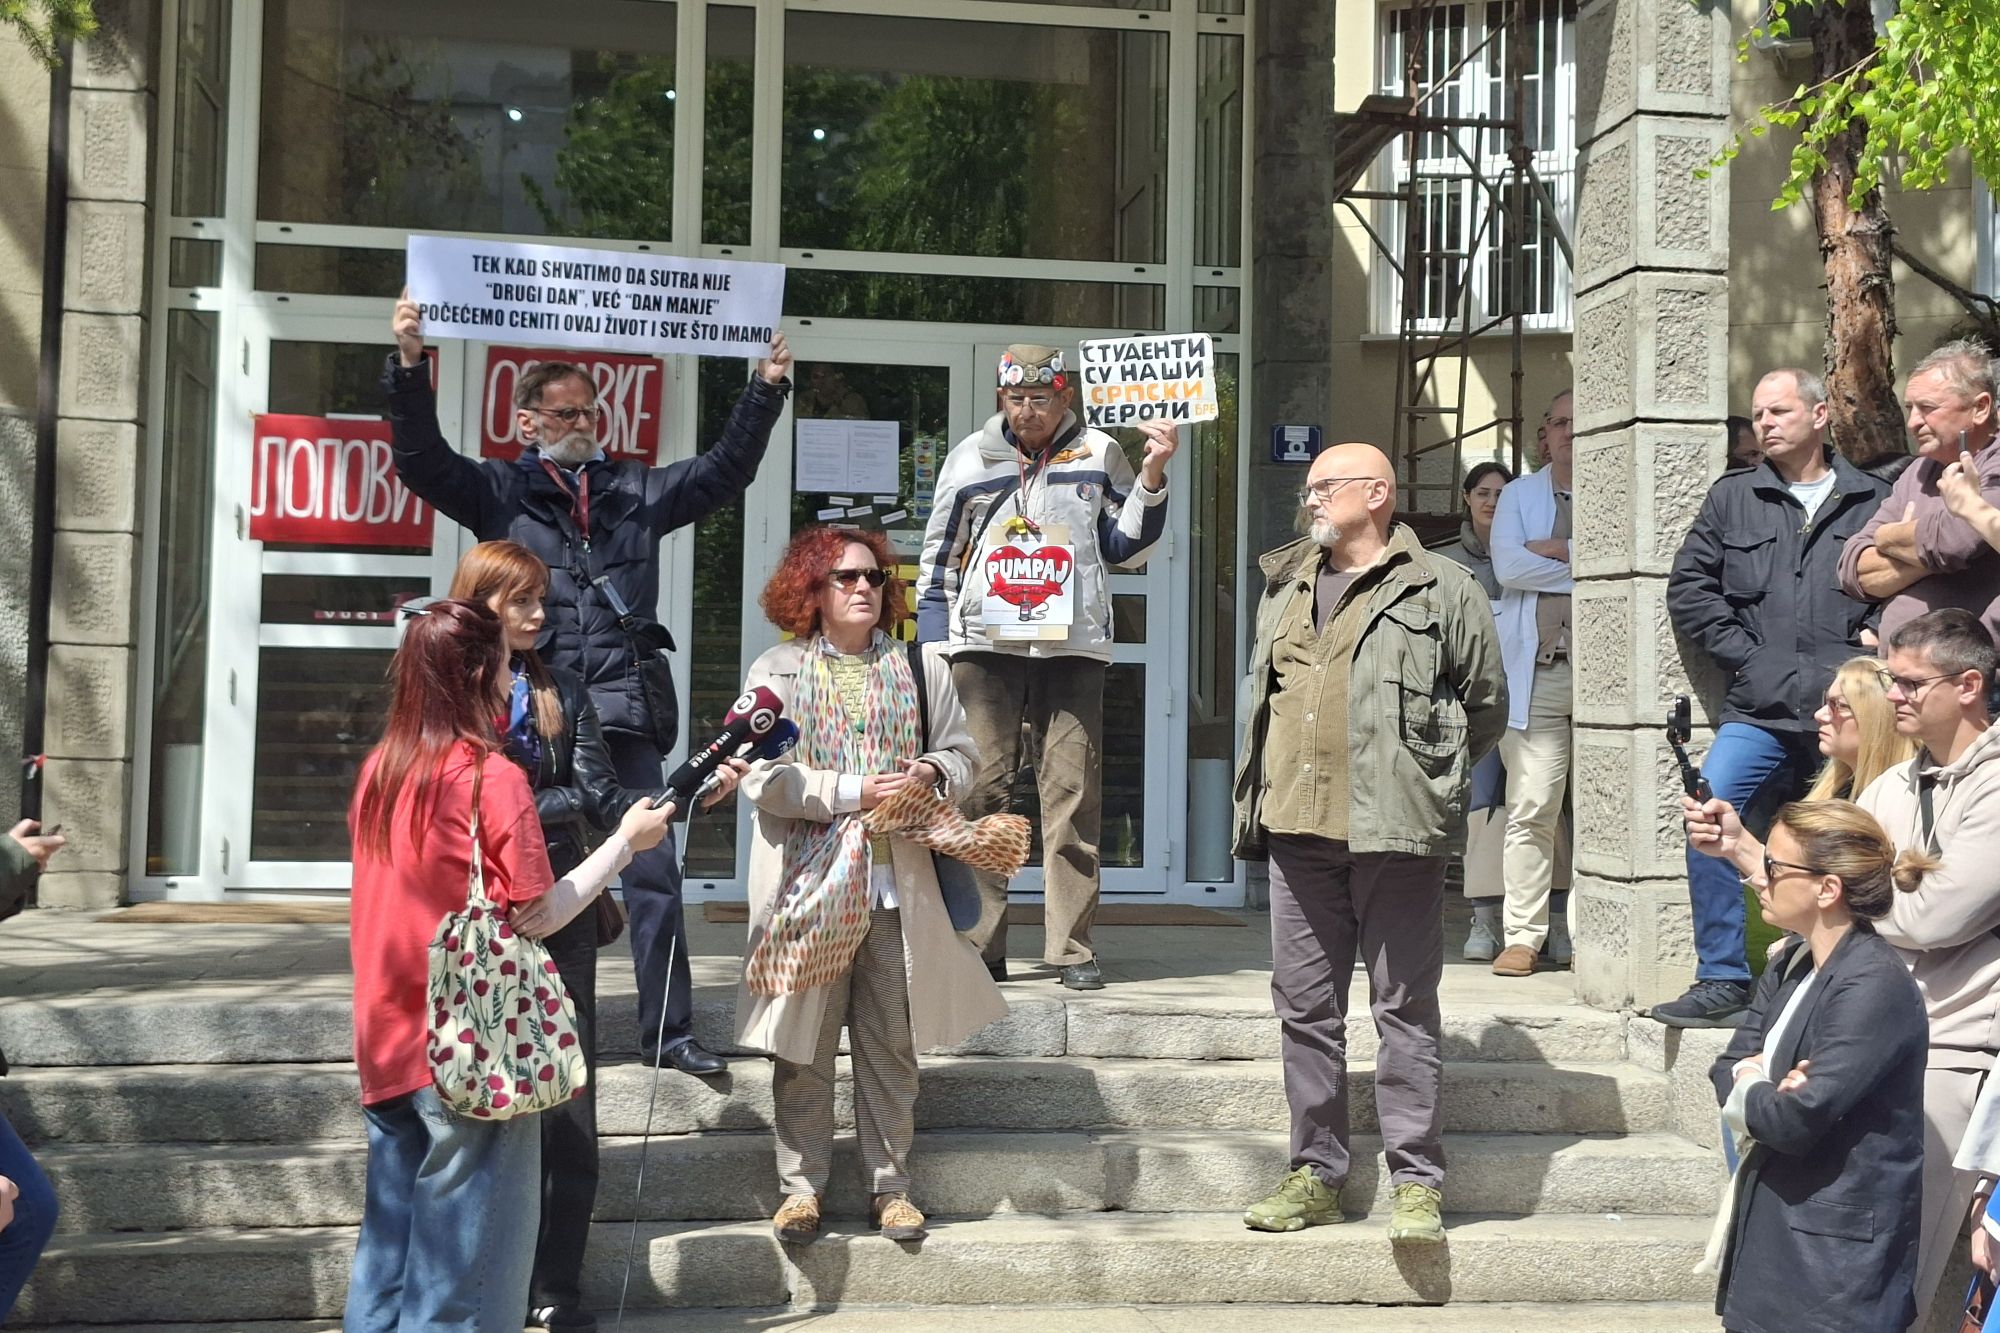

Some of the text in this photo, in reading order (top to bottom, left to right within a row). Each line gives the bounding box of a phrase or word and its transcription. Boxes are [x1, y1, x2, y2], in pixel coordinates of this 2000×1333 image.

[472, 254, 731, 292] TEK KAD SHVATIMO DA SUTRA NIJE
[592, 288, 621, 310] VEĆ
[418, 301, 773, 344] POČEĆEMO CENITI OVAJ ŽIVOT I SVE ŠTO IMAMO
[1082, 337, 1206, 363] СТУДЕНТИ
[1085, 360, 1204, 384] СУ НАШИ
[1090, 380, 1204, 405] СРПСКИ
[486, 359, 657, 455] ОВКЕ
[987, 557, 1069, 583] PUMPAJ
[323, 610, 378, 621] VUCI
